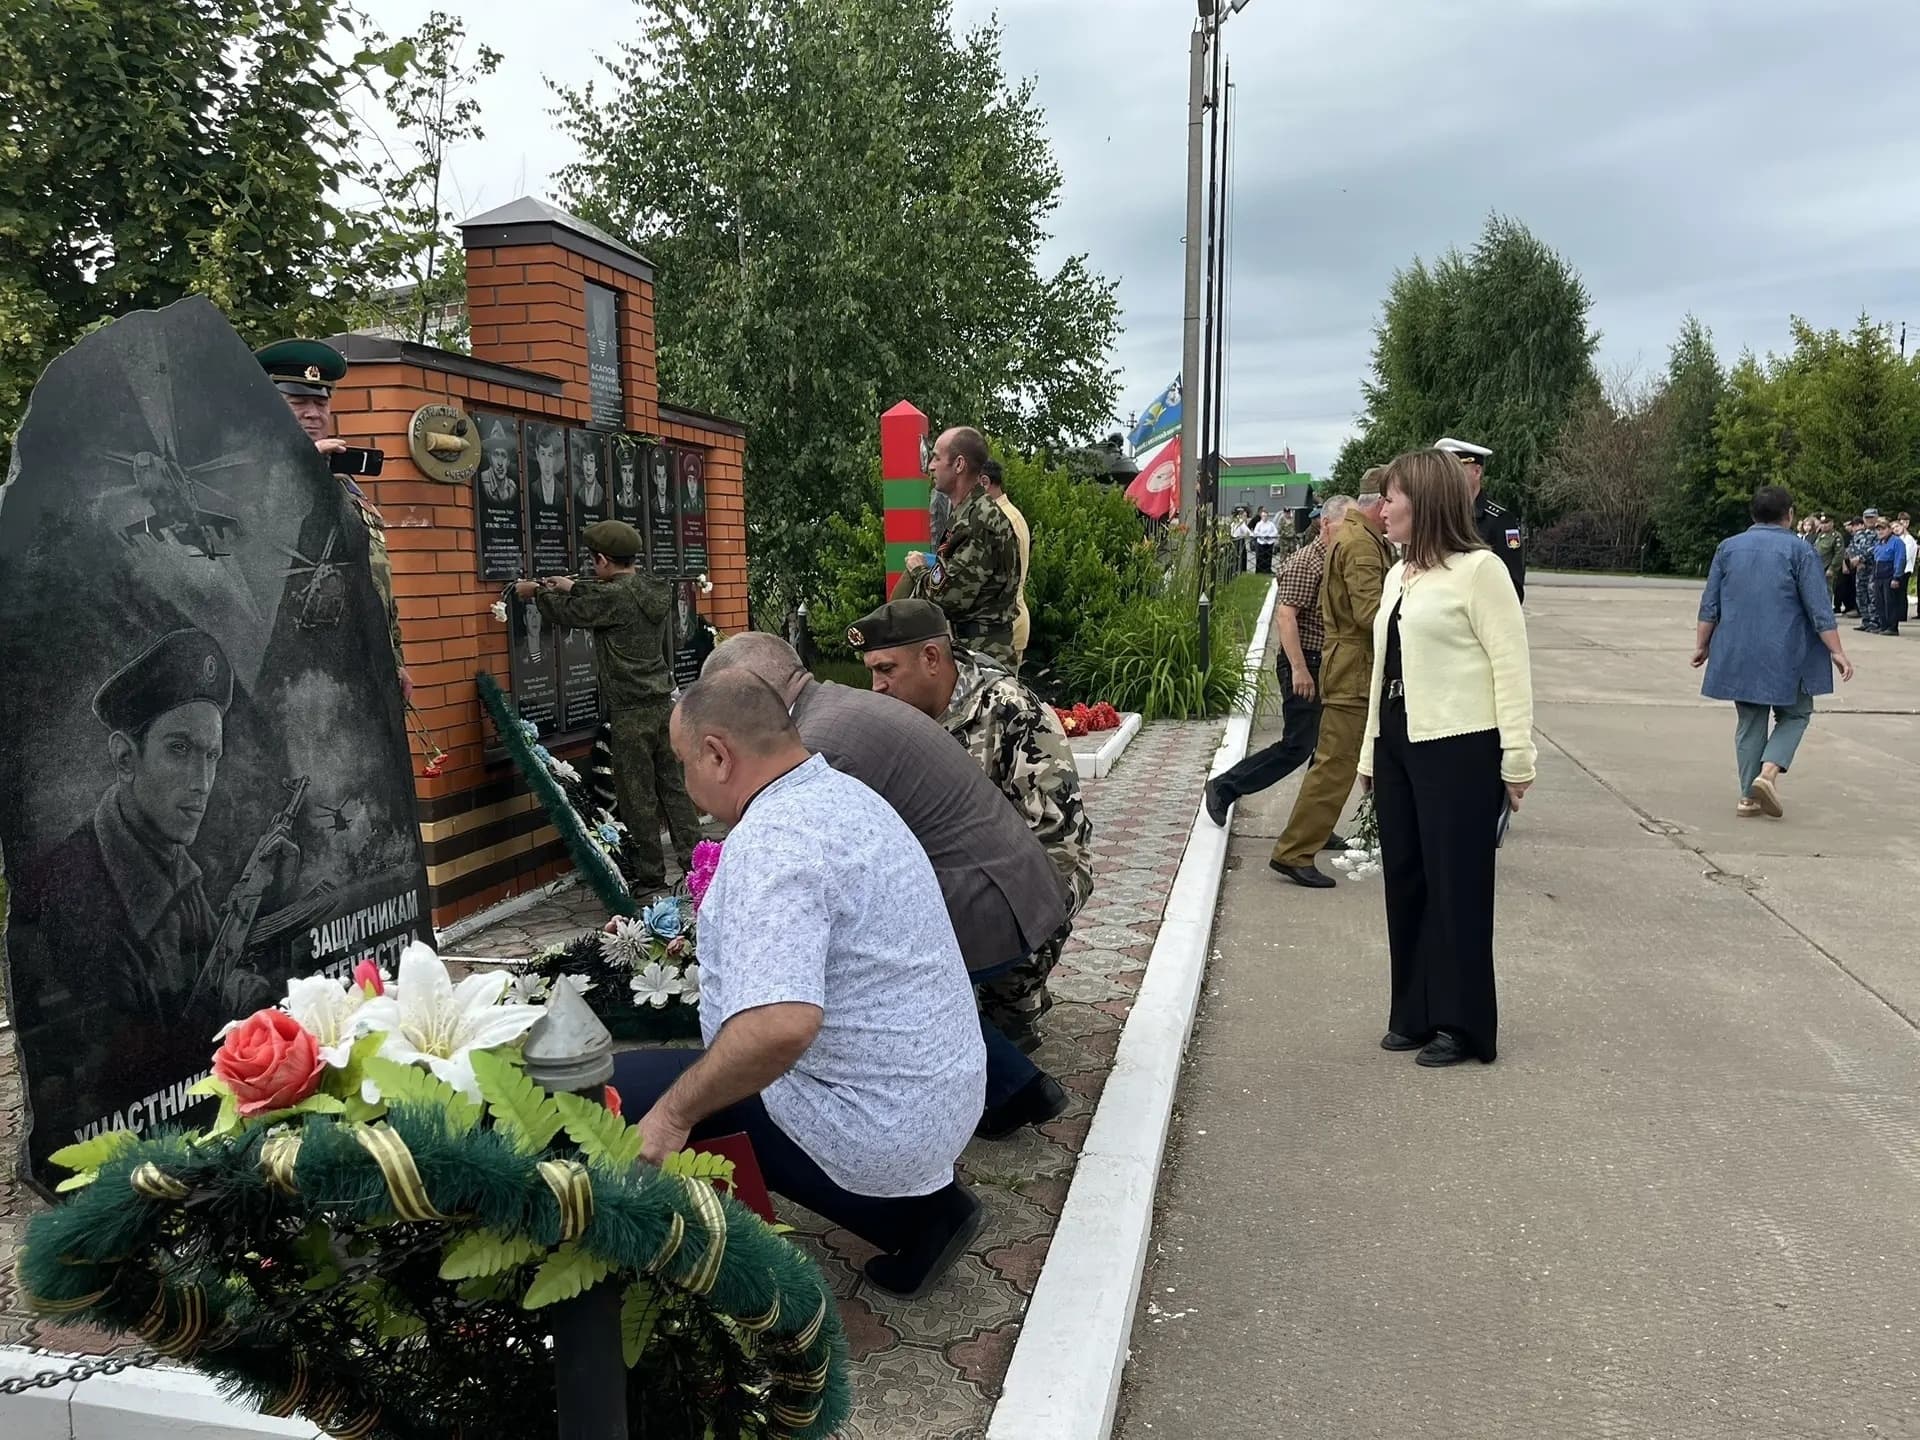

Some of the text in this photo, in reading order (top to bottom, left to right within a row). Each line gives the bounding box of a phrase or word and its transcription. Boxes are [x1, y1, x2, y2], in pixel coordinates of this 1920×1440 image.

[591, 363, 616, 376] АСАПОВ
[414, 406, 459, 440] АФГАНИСТАН
[310, 889, 419, 959] ЗАЩИТНИКАМ
[313, 928, 419, 979] ТЕЧСТВ
